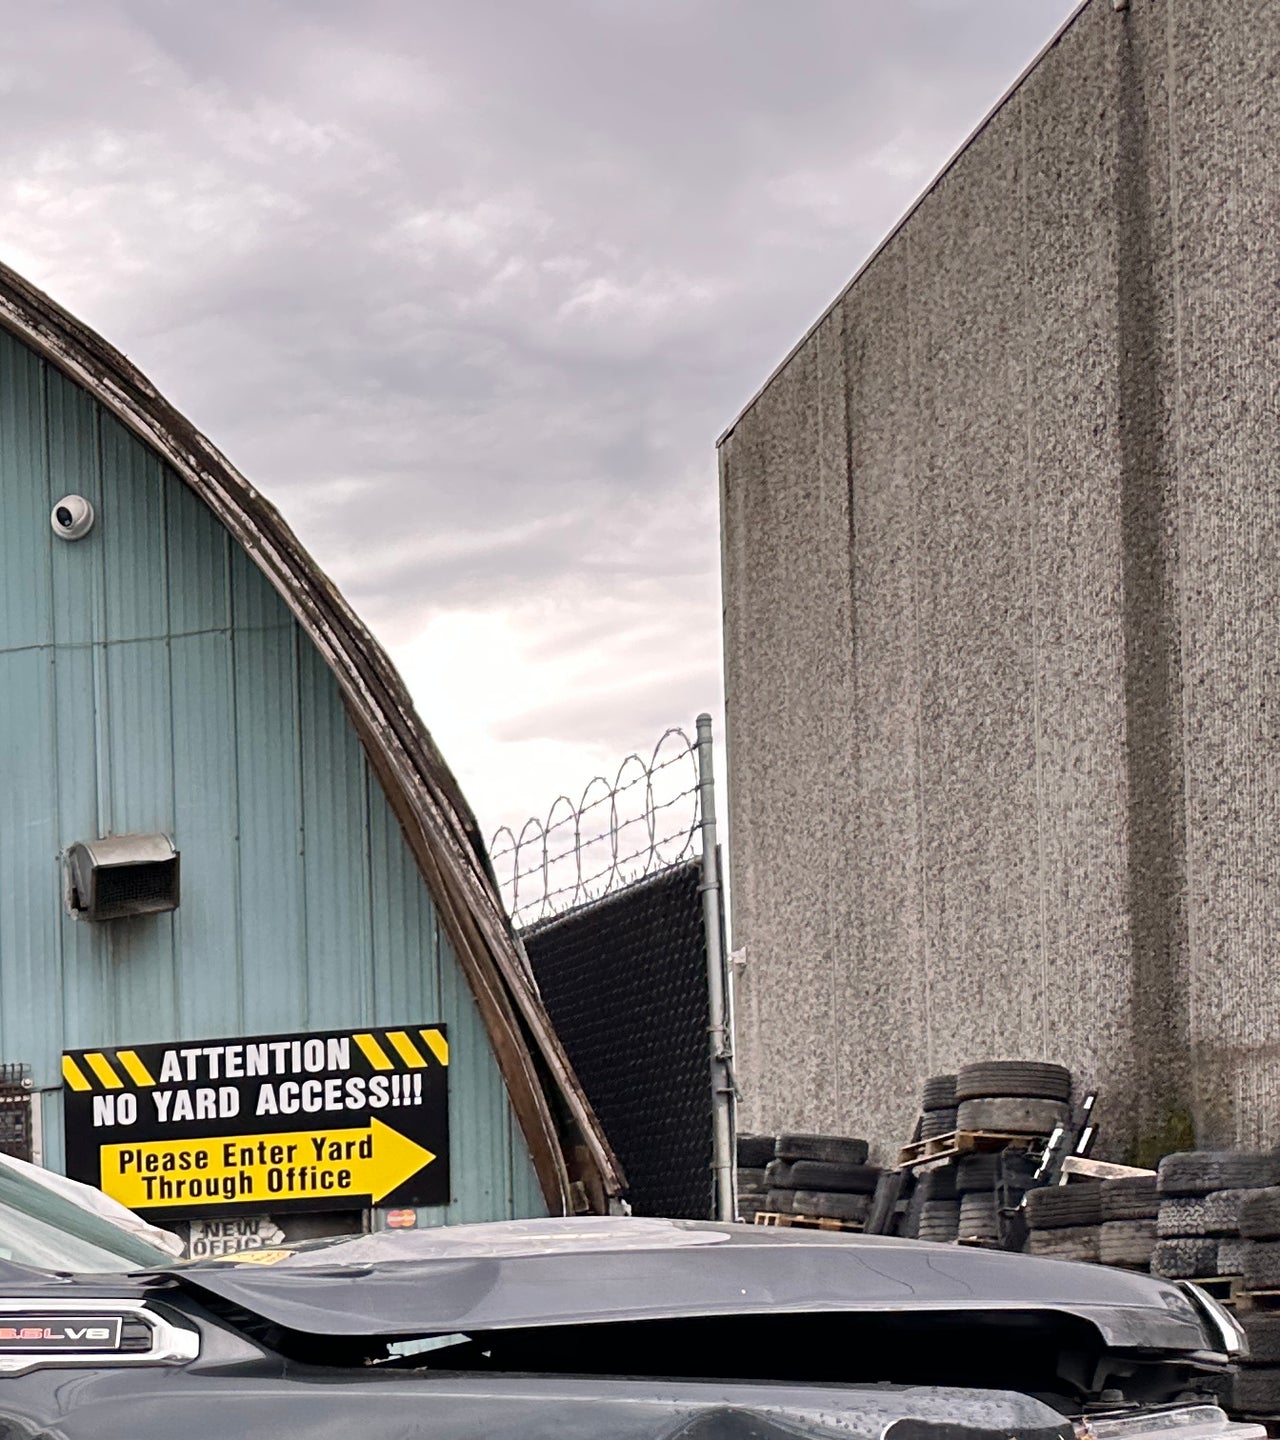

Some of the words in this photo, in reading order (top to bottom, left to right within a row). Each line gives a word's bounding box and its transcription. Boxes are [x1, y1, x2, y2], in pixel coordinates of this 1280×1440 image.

[159, 1037, 351, 1083] ATTENTION
[93, 1093, 137, 1127] NO
[152, 1086, 240, 1122] YARD
[255, 1073, 423, 1116] ACCESS!!!
[119, 1148, 209, 1175] Please
[223, 1140, 298, 1167] Enter
[311, 1134, 373, 1161] Yard
[141, 1172, 253, 1201] Through
[267, 1166, 352, 1192] Office
[202, 1217, 260, 1239] NEW
